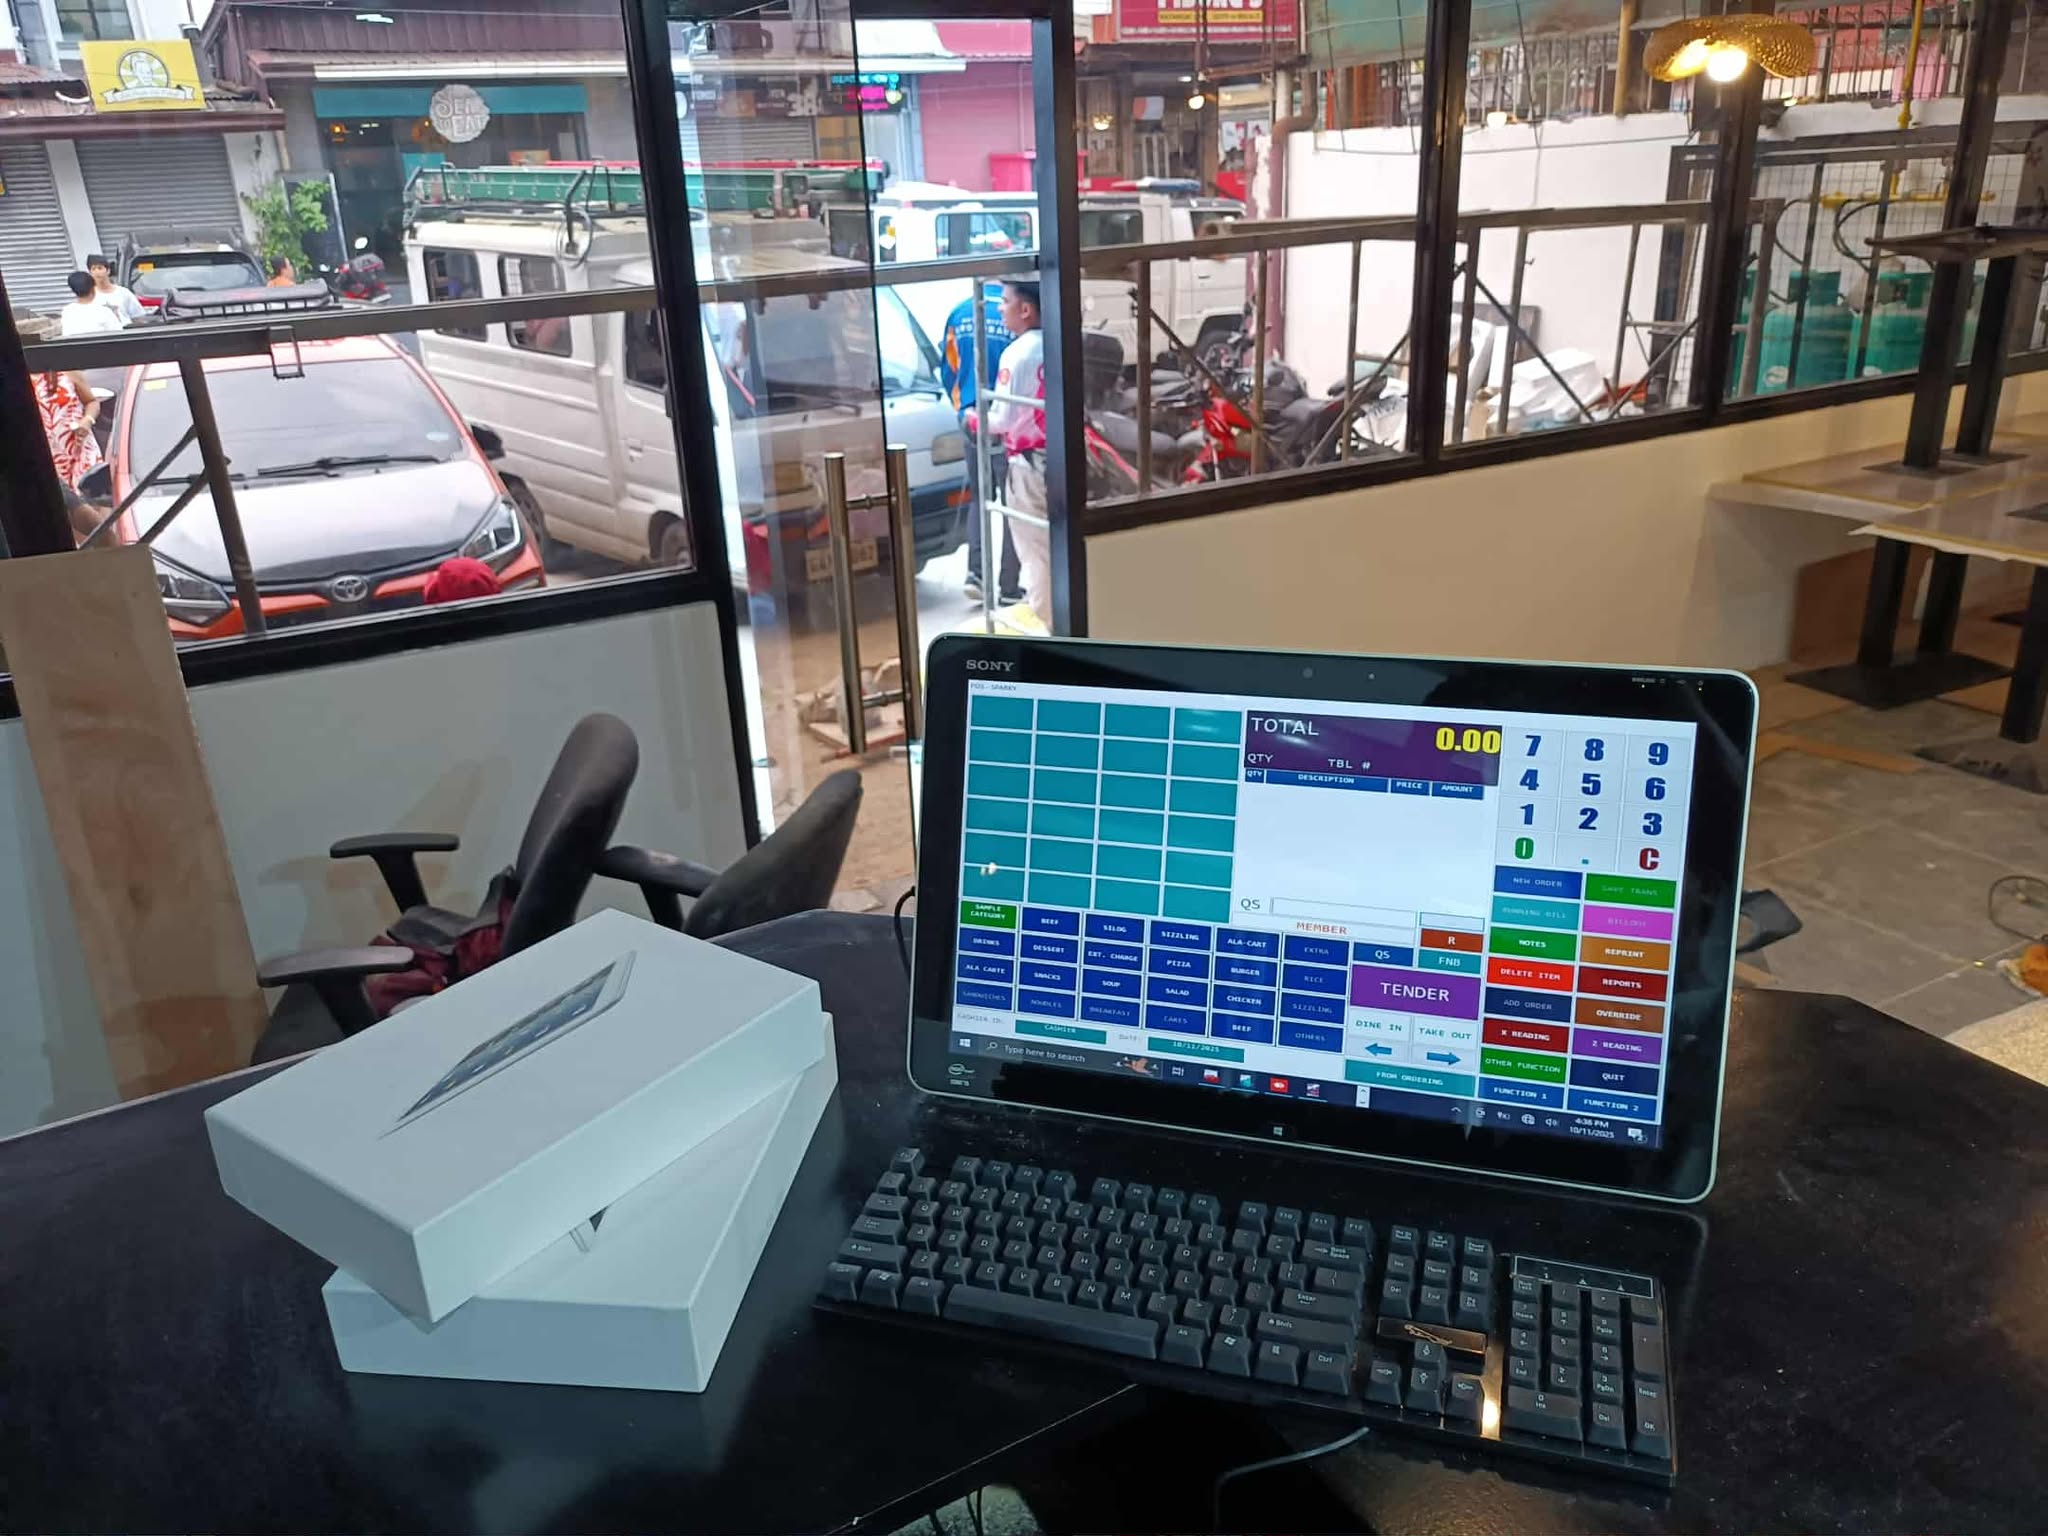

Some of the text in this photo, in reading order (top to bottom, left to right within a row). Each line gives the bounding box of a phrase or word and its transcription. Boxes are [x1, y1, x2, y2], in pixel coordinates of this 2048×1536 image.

[966, 659, 1014, 672] SONY
[1251, 717, 1501, 754] TOTAL 0.00
[1525, 735, 1669, 766] 7 8 9
[1248, 754, 1370, 770] QTY TBL #
[1248, 770, 1474, 793] QTY DESCRIPTION PRICE AMOUNT
[1520, 769, 1666, 800] 4 5 6
[1520, 804, 1662, 836] 1 2 3
[1515, 837, 1534, 860] 0
[1639, 848, 1660, 870] C
[1513, 877, 1562, 888] NEW ORDER
[975, 904, 1002, 912] SAMPLE
[1240, 898, 1260, 910] QS
[970, 910, 1006, 920] CATEGORY
[1297, 922, 1348, 935] MEMBER
[1161, 931, 1200, 940] SIZZLING
[1448, 936, 1456, 945] R
[973, 938, 1000, 946] DRINKS
[1519, 940, 1546, 948] NOTES
[1033, 944, 1064, 954] DESSERT
[1605, 948, 1644, 958] REPRINT
[1110, 953, 1138, 962] CHARGE
[1375, 950, 1390, 960] QS
[1166, 960, 1191, 968] PIZZA
[1439, 956, 1461, 966] FNB
[983, 966, 1006, 974] CARTE
[1230, 967, 1260, 976] BURGER
[1500, 968, 1560, 980] DELETE ITEM
[1034, 972, 1061, 981] SNACKS
[1304, 976, 1324, 984] RICE
[1602, 978, 1642, 988] REPORTS
[1165, 988, 1190, 996] SALAD
[1380, 982, 1450, 1002] TENDER
[1227, 996, 1262, 1006] CHICKEN
[1525, 1002, 1552, 1010] ORDER
[1596, 1010, 1642, 1021] OVERRIDE
[1232, 1024, 1252, 1032] BEEF
[1356, 1020, 1402, 1032] DINE IN
[1295, 1032, 1326, 1042] OTHERS
[1419, 1028, 1472, 1040] TAKE OUT
[1512, 1030, 1550, 1041] READING
[1603, 1042, 1642, 1052] READING
[1005, 1045, 1024, 1055] Type
[1026, 1048, 1044, 1057] here
[1058, 1054, 1086, 1062] search
[1486, 1058, 1560, 1072] OTHER FUNCTION
[1402, 1074, 1443, 1086] ORDERING
[1494, 1087, 1536, 1098] FUNCTION
[1584, 1099, 1628, 1110] FUNCTION
[1088, 1285, 1096, 1293] N
[1121, 1292, 1131, 1300] M
[1318, 1354, 1333, 1363] Ctrl
